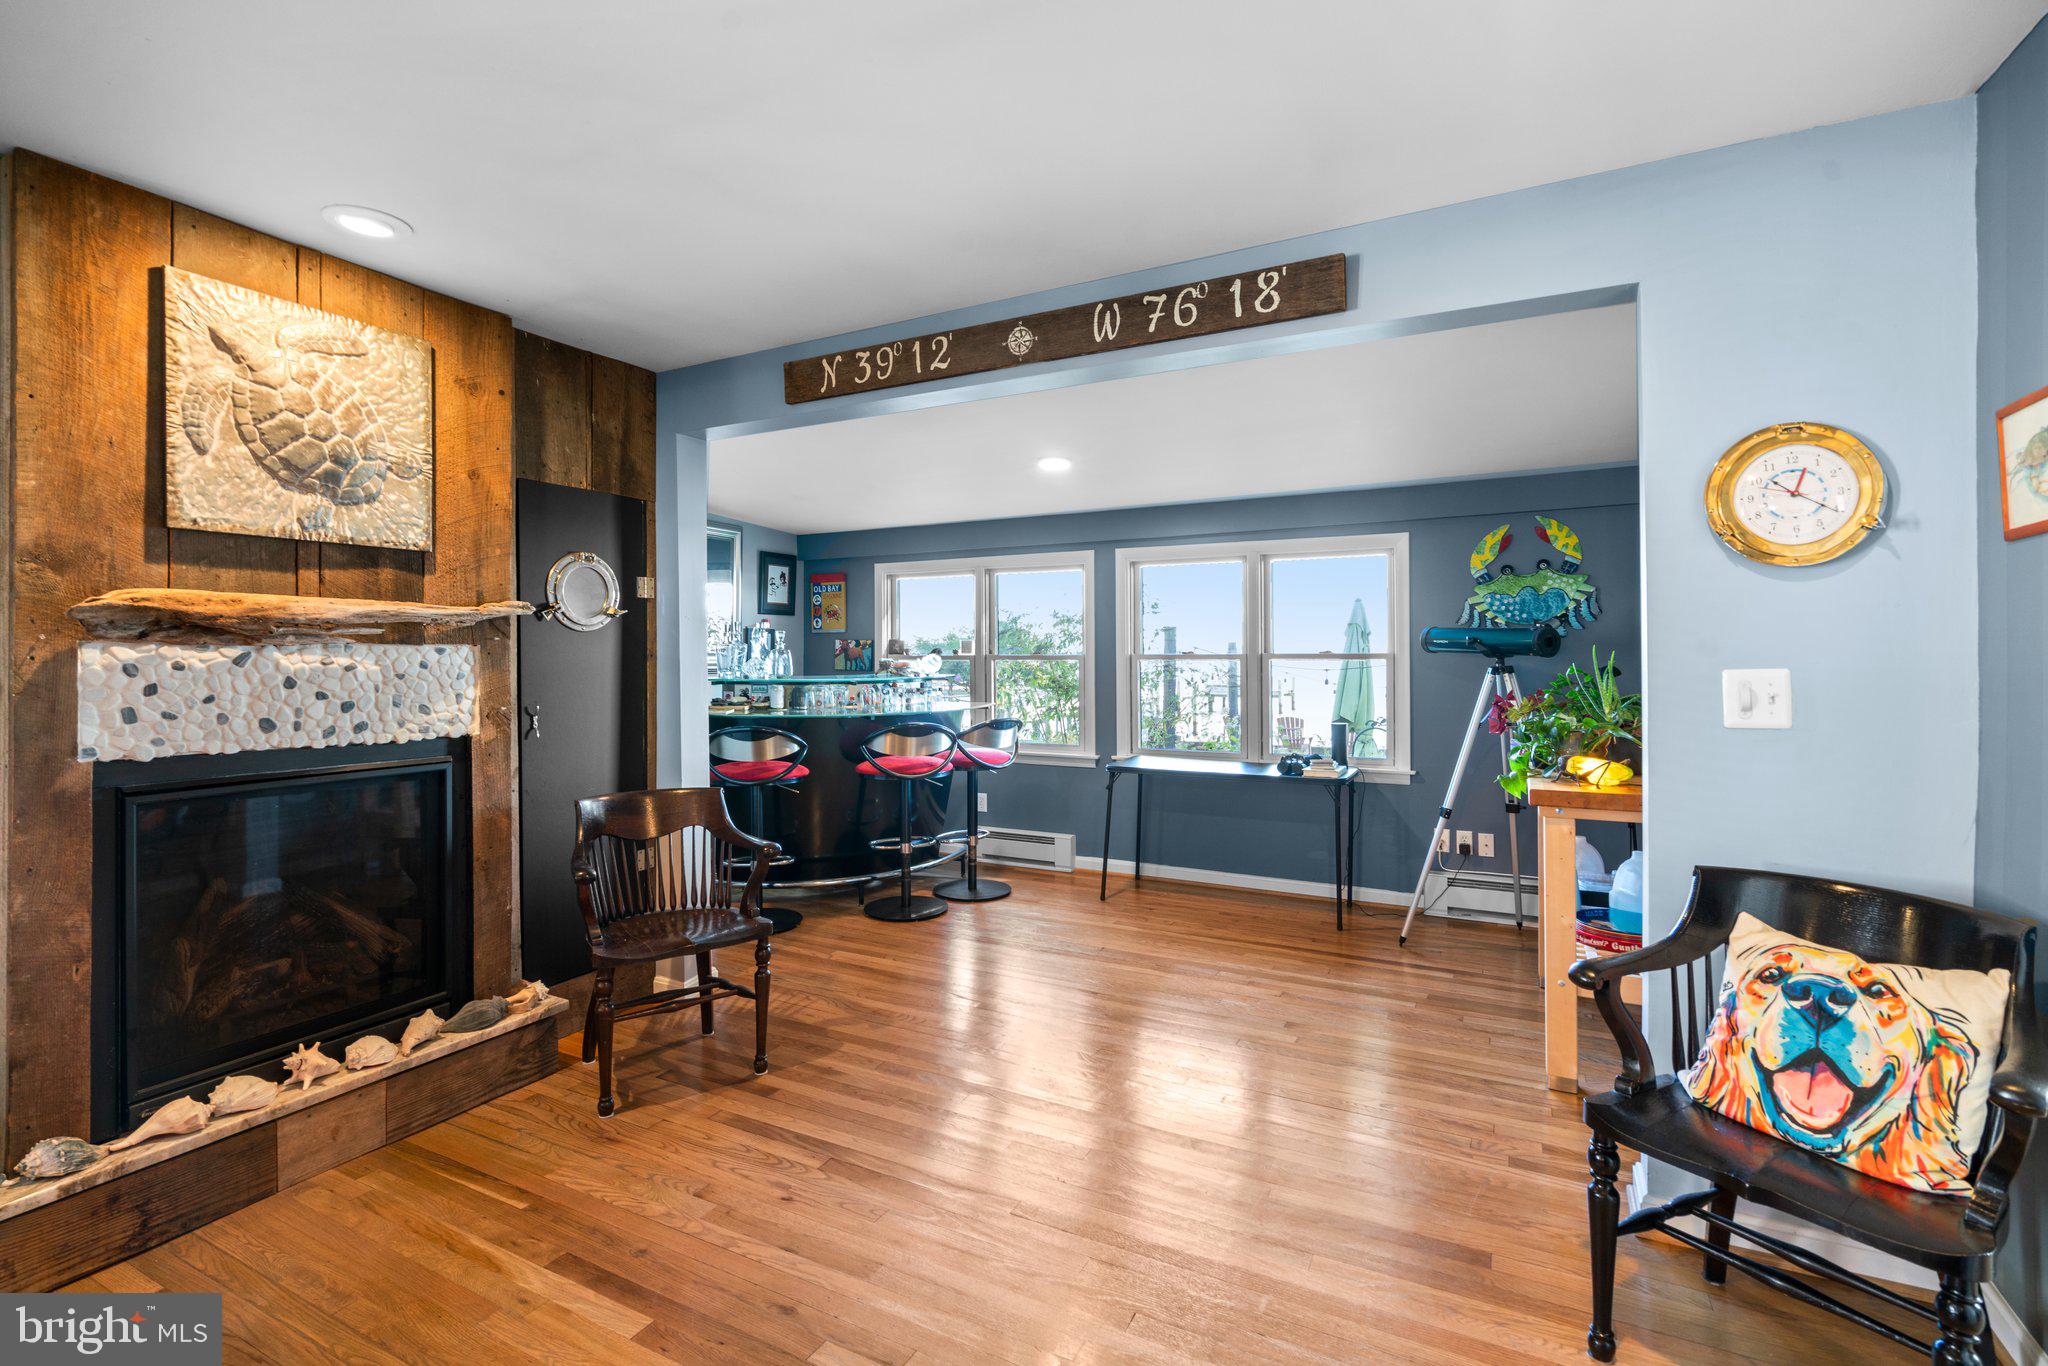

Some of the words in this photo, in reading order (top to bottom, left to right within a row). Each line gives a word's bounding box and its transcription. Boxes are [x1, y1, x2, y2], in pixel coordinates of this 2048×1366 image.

[820, 355, 842, 393] N
[1093, 302, 1121, 343] W
[1786, 456, 1799, 464] 12
[1764, 463, 1775, 471] 11
[813, 585, 827, 593] OLD
[827, 584, 840, 593] BAY
